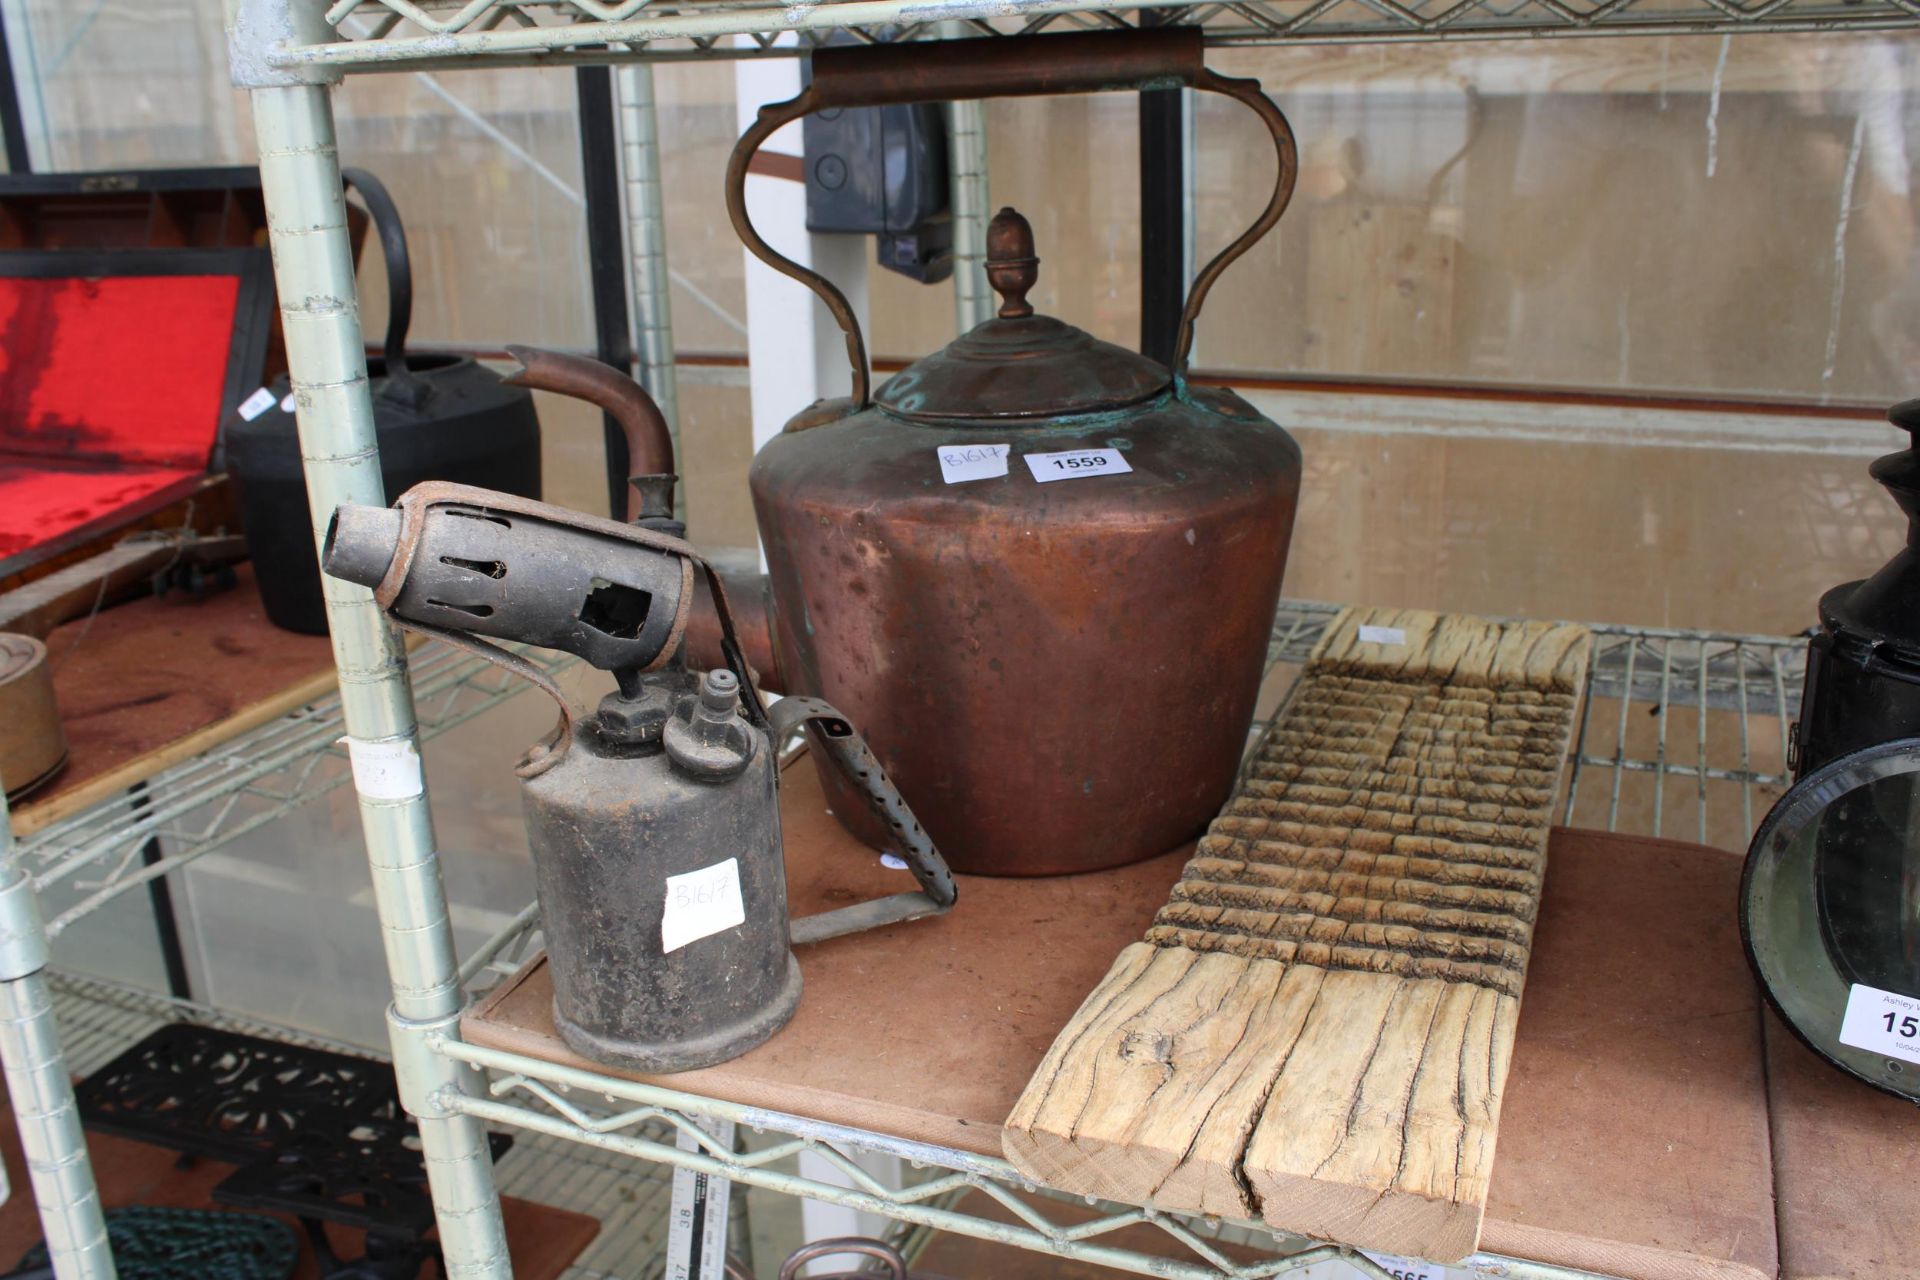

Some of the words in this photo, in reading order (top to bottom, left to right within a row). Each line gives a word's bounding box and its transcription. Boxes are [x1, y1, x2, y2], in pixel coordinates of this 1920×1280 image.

[1053, 456, 1107, 470] 1559
[1882, 995, 1914, 1010] Ashley
[1882, 1011, 1920, 1038] 15
[680, 1208, 691, 1229] 38
